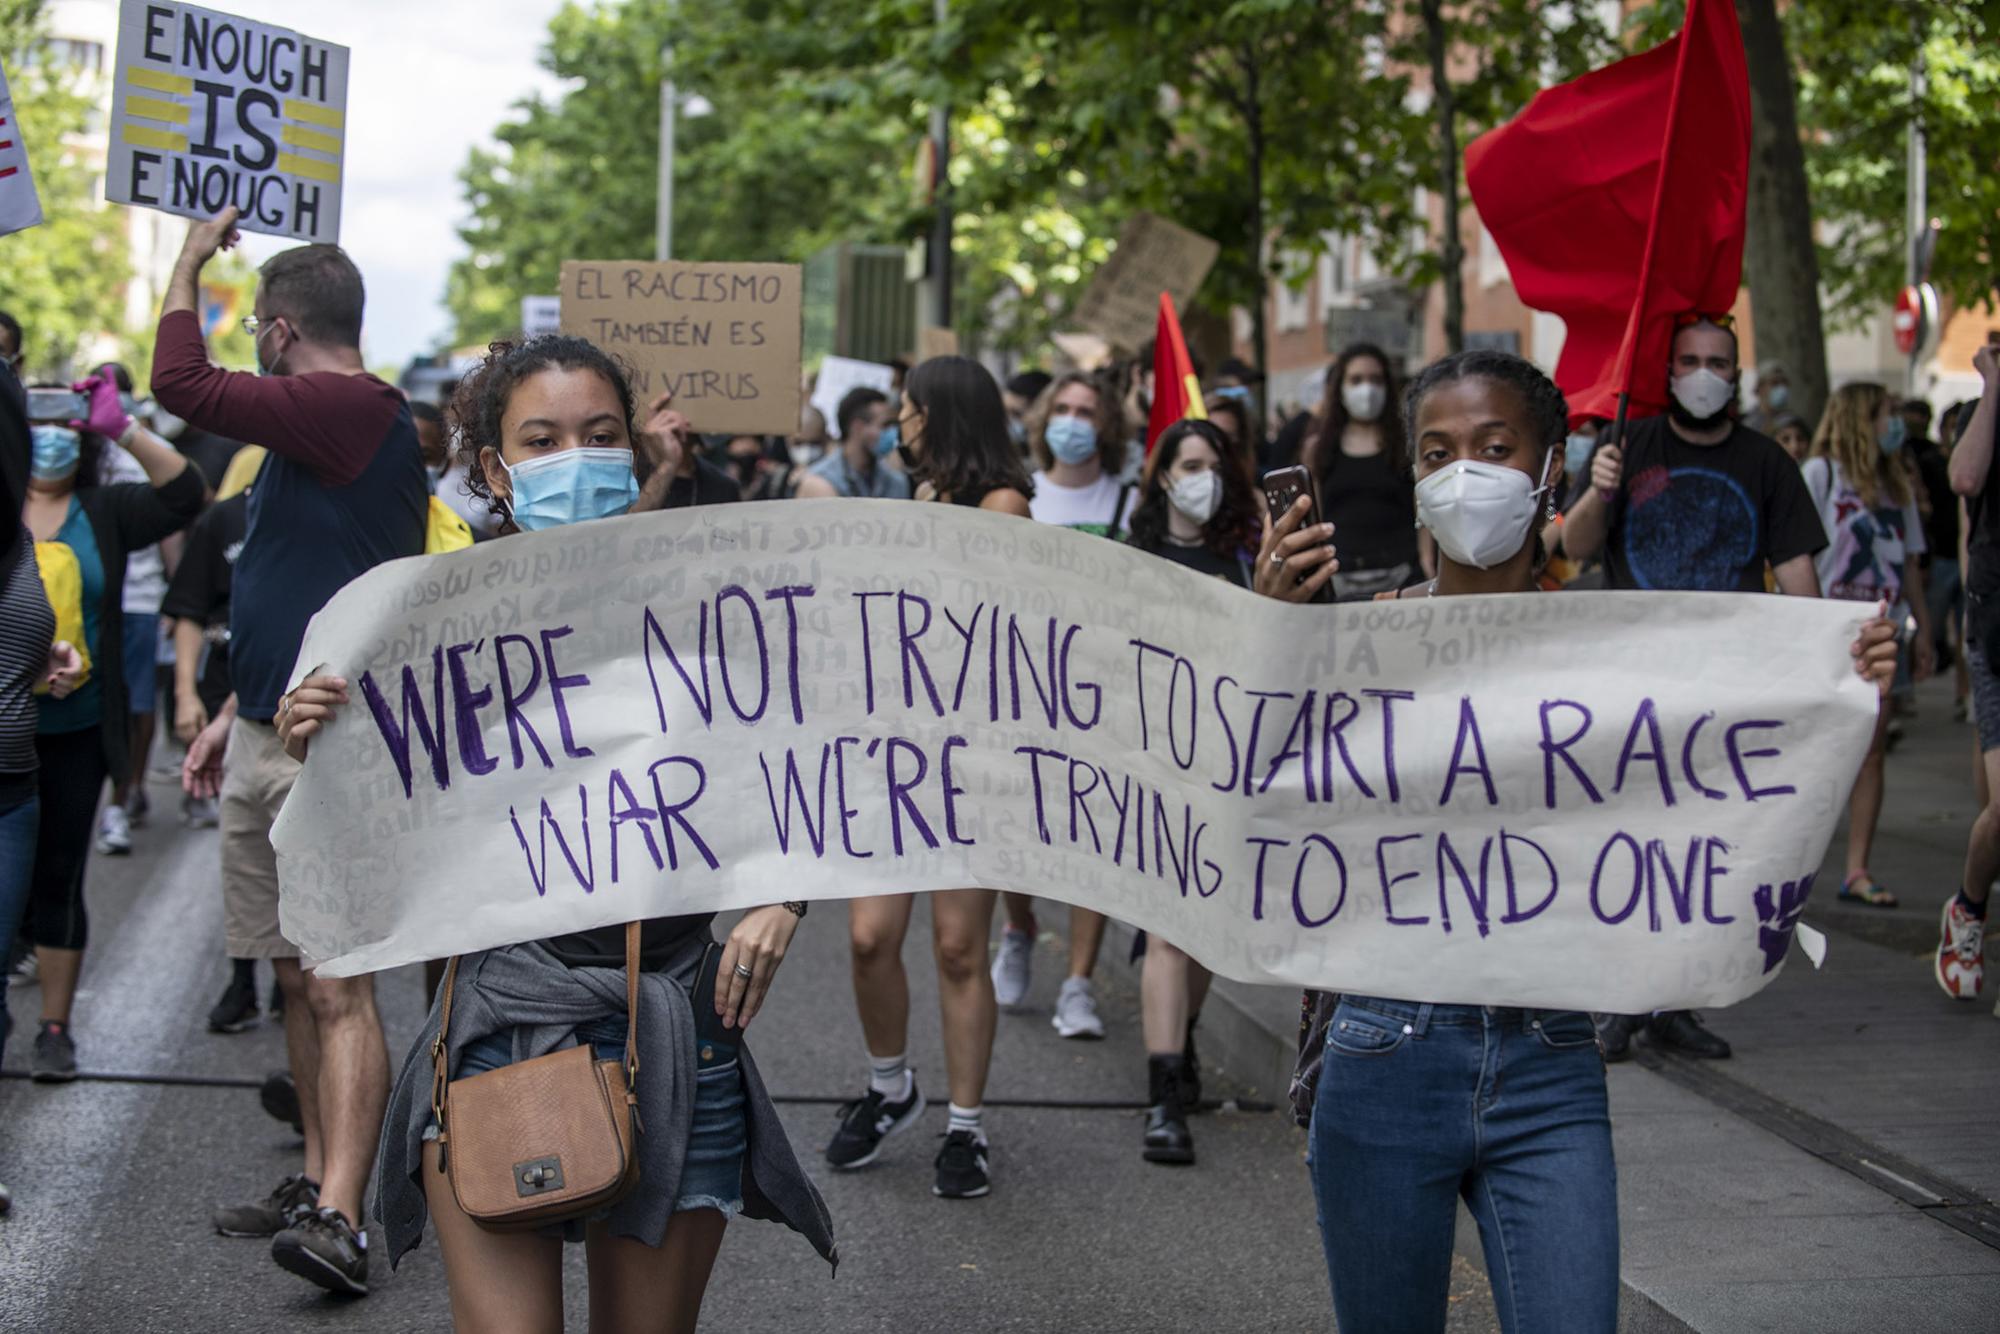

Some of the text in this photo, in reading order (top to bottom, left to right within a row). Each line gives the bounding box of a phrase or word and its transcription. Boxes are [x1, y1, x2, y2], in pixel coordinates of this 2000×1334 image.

[144, 5, 328, 102] ENOUGH
[190, 79, 280, 172] IS
[130, 150, 320, 237] ENOUGH
[576, 267, 781, 304] EL RACISMO
[592, 314, 712, 346] TAMBIÉN
[730, 321, 765, 346] ES
[661, 369, 760, 401] VIRUS
[358, 586, 1796, 808] WE'RE NOT TRYING TO START A RACE
[510, 755, 720, 897] WAR
[759, 736, 975, 858] WE'RE
[1014, 745, 1222, 898] TRYING
[1246, 834, 1347, 928] TO
[1375, 828, 1558, 938] END
[1588, 831, 1738, 932] ONE
